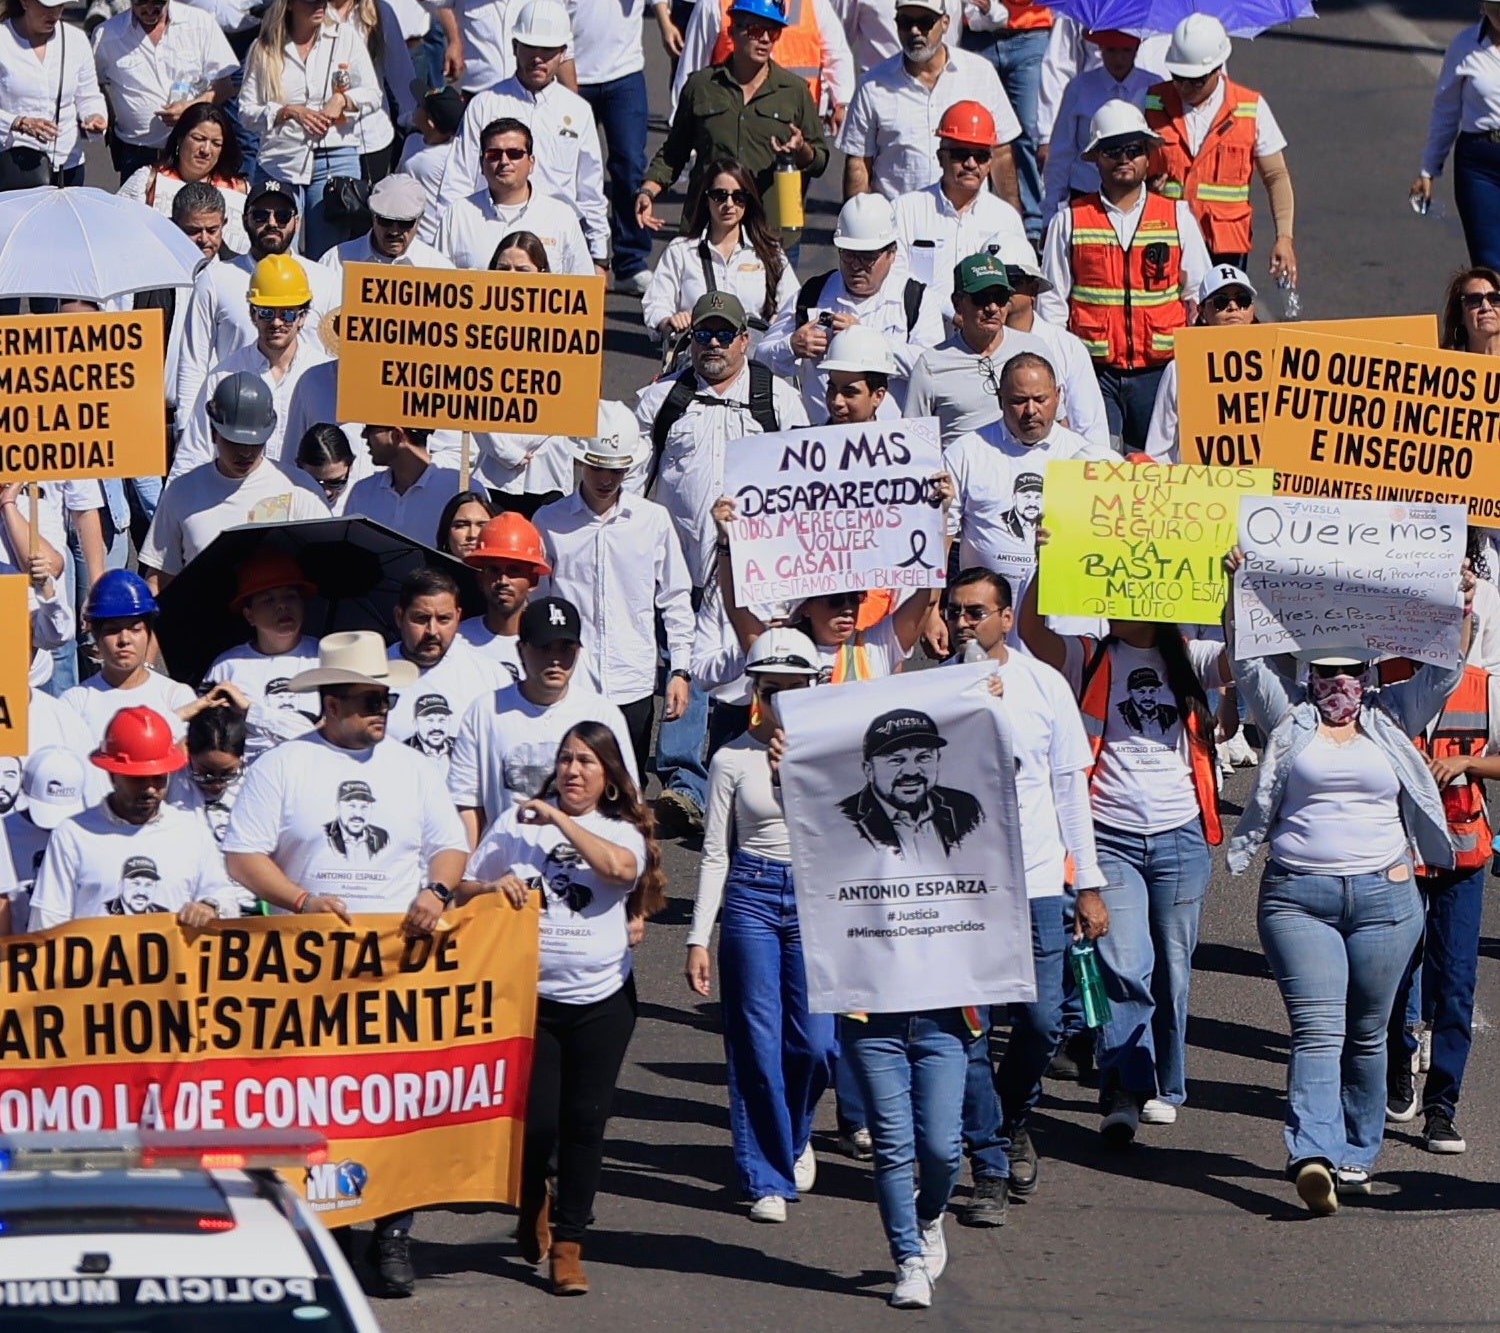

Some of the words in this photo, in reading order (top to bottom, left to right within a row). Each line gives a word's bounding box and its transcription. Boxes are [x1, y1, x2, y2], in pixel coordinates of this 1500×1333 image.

[362, 278, 473, 309] EXIGIMOS
[480, 286, 587, 315] JUSTICIA
[347, 316, 457, 347] EXIGIMOS
[466, 324, 601, 356] SEGURIDAD
[382, 361, 493, 392] EXIGIMOS
[501, 368, 561, 395] CERO
[1208, 350, 1262, 383] LOS
[38, 404, 70, 431] LA
[79, 402, 109, 429] DE
[403, 391, 537, 423] IMPUNIDAD
[778, 440, 827, 472] NO
[839, 433, 912, 471] MAS
[1083, 461, 1256, 488] EXIGIMOS
[735, 476, 943, 517] DESAPARECIDOS
[776, 506, 903, 537] MERECEMOS
[1247, 506, 1453, 548] Queremos
[798, 528, 880, 553] VOLVER
[745, 559, 766, 583] A
[1131, 600, 1177, 619] LUTO
[839, 884, 909, 901] ANTONIO
[916, 880, 988, 896] ESPARZA
[847, 921, 985, 941] #MinerosDesaparecidos
[887, 909, 939, 921] #Justicia
[198, 930, 384, 995] ¡BASTA
[403, 928, 460, 977] DE
[82, 979, 495, 1055] HONESTAMENTE!
[114, 1081, 164, 1133] LA
[174, 1078, 225, 1131] DE
[234, 1059, 505, 1129] CONCORDIA!
